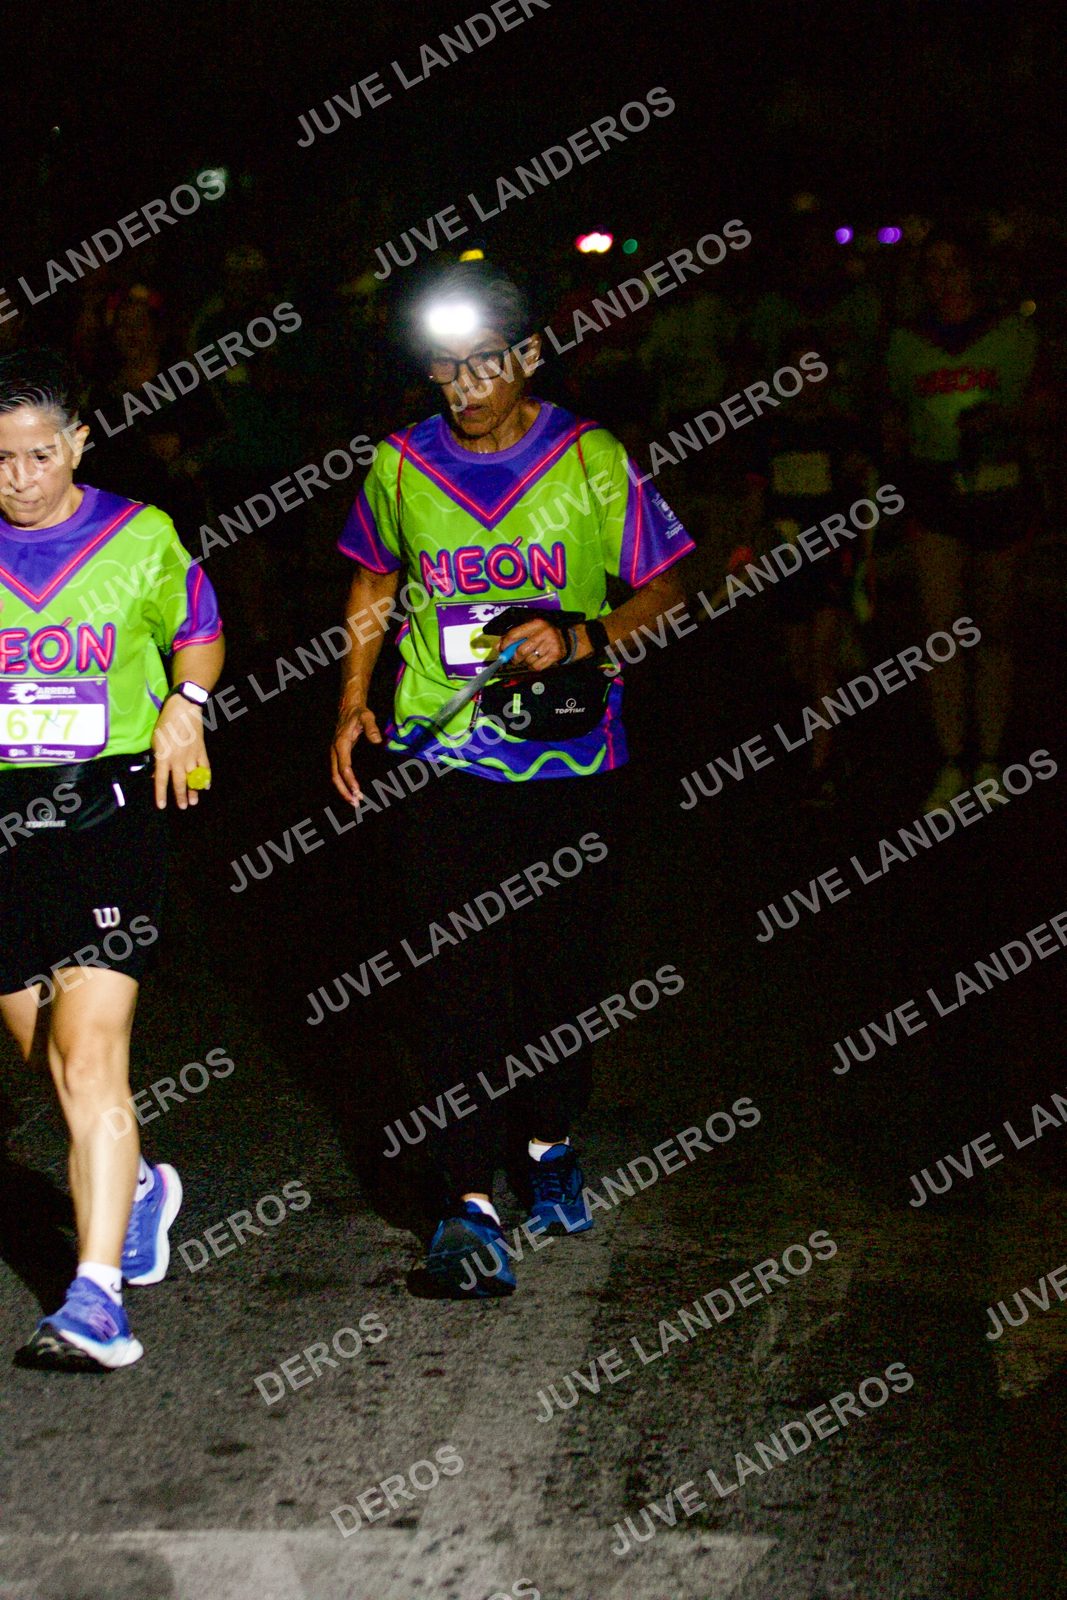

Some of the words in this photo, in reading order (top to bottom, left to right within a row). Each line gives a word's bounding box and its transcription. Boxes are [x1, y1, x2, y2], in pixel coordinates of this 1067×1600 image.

[419, 536, 566, 597] NEÓN
[0, 617, 116, 674] EÓN
[6, 708, 79, 741] 677
